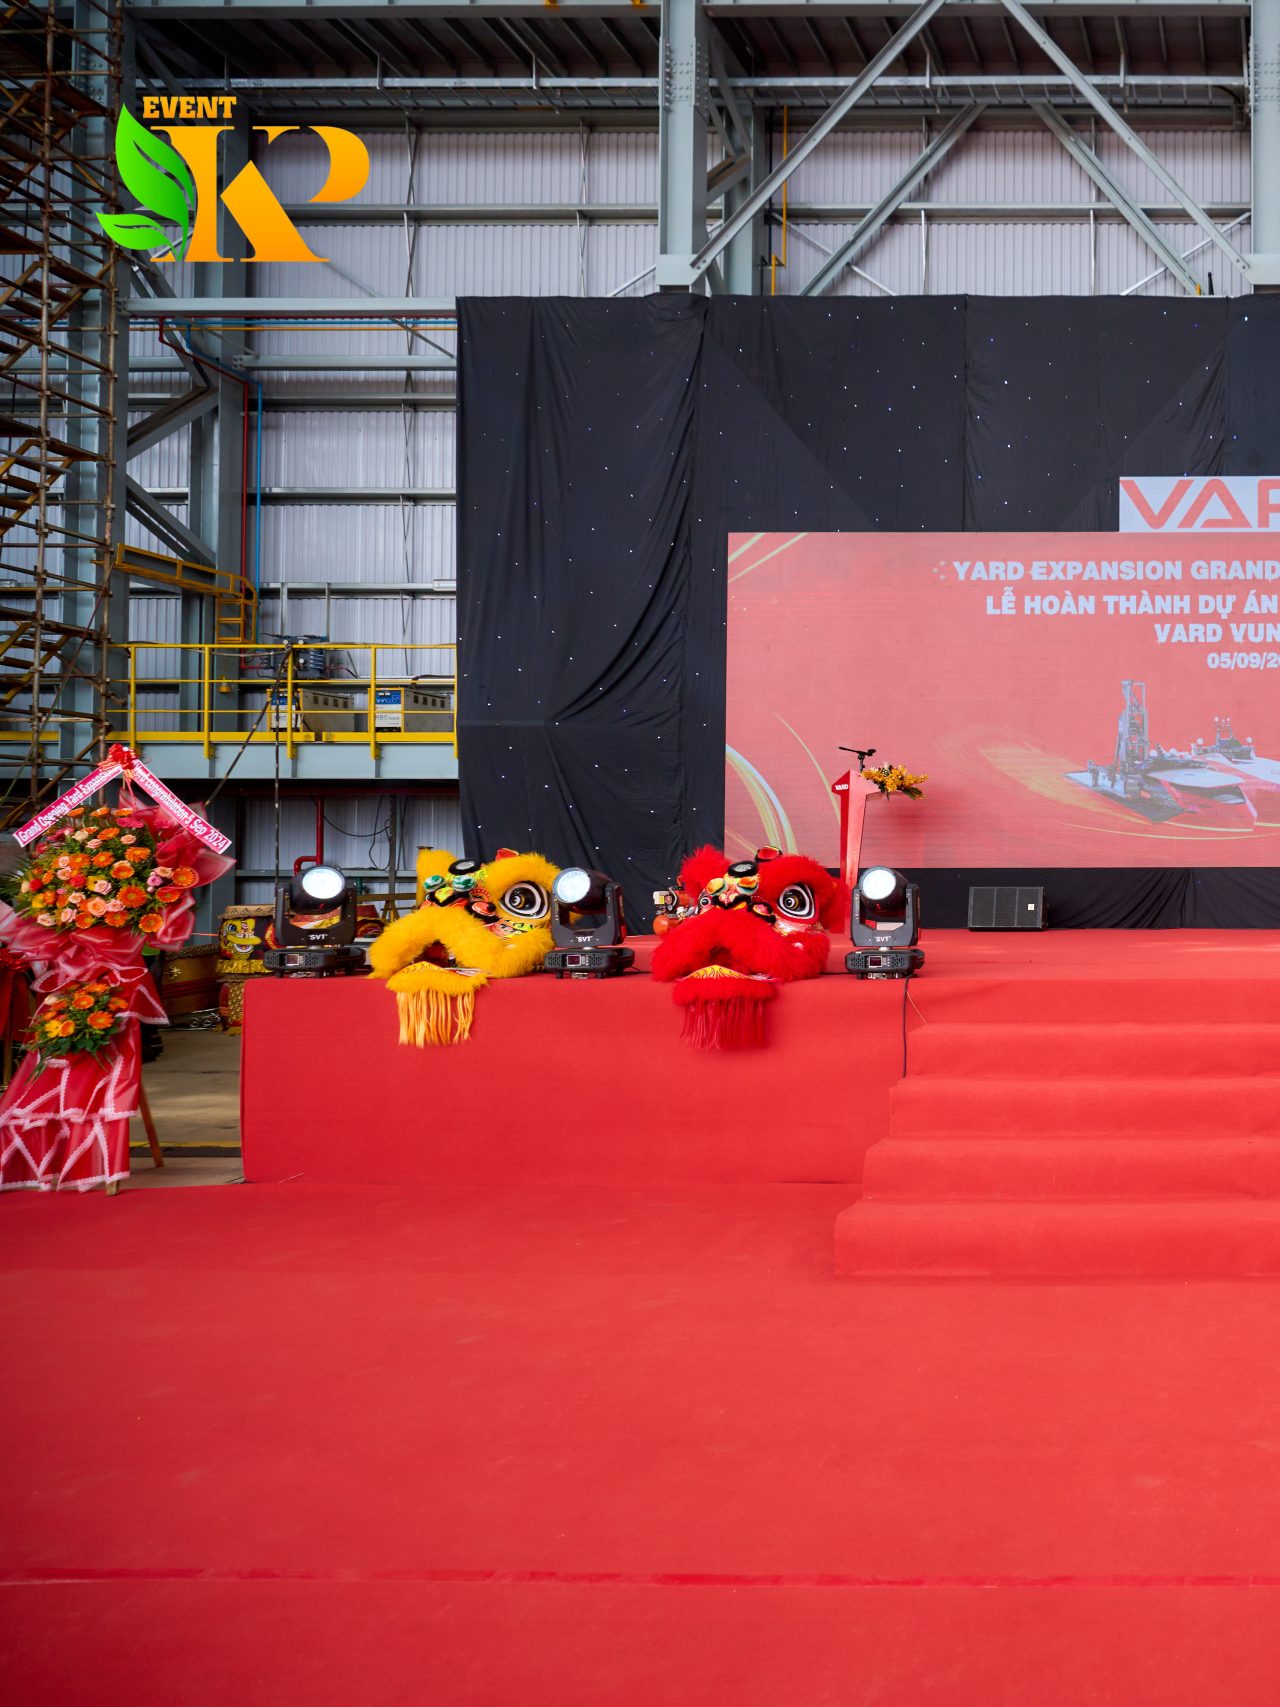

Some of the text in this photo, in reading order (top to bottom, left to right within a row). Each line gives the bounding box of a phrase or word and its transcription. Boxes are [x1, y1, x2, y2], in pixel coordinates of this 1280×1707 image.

[953, 561, 1024, 580] YARD
[1032, 560, 1182, 580] EXPANSION
[986, 587, 1016, 614] LỄ
[1024, 590, 1095, 614] HOÀN
[1103, 590, 1190, 614] THÀNH
[1198, 595, 1236, 619] DỰ
[1243, 589, 1278, 614] ÁN
[189, 818, 208, 836] Sep
[203, 829, 227, 850] 2024
